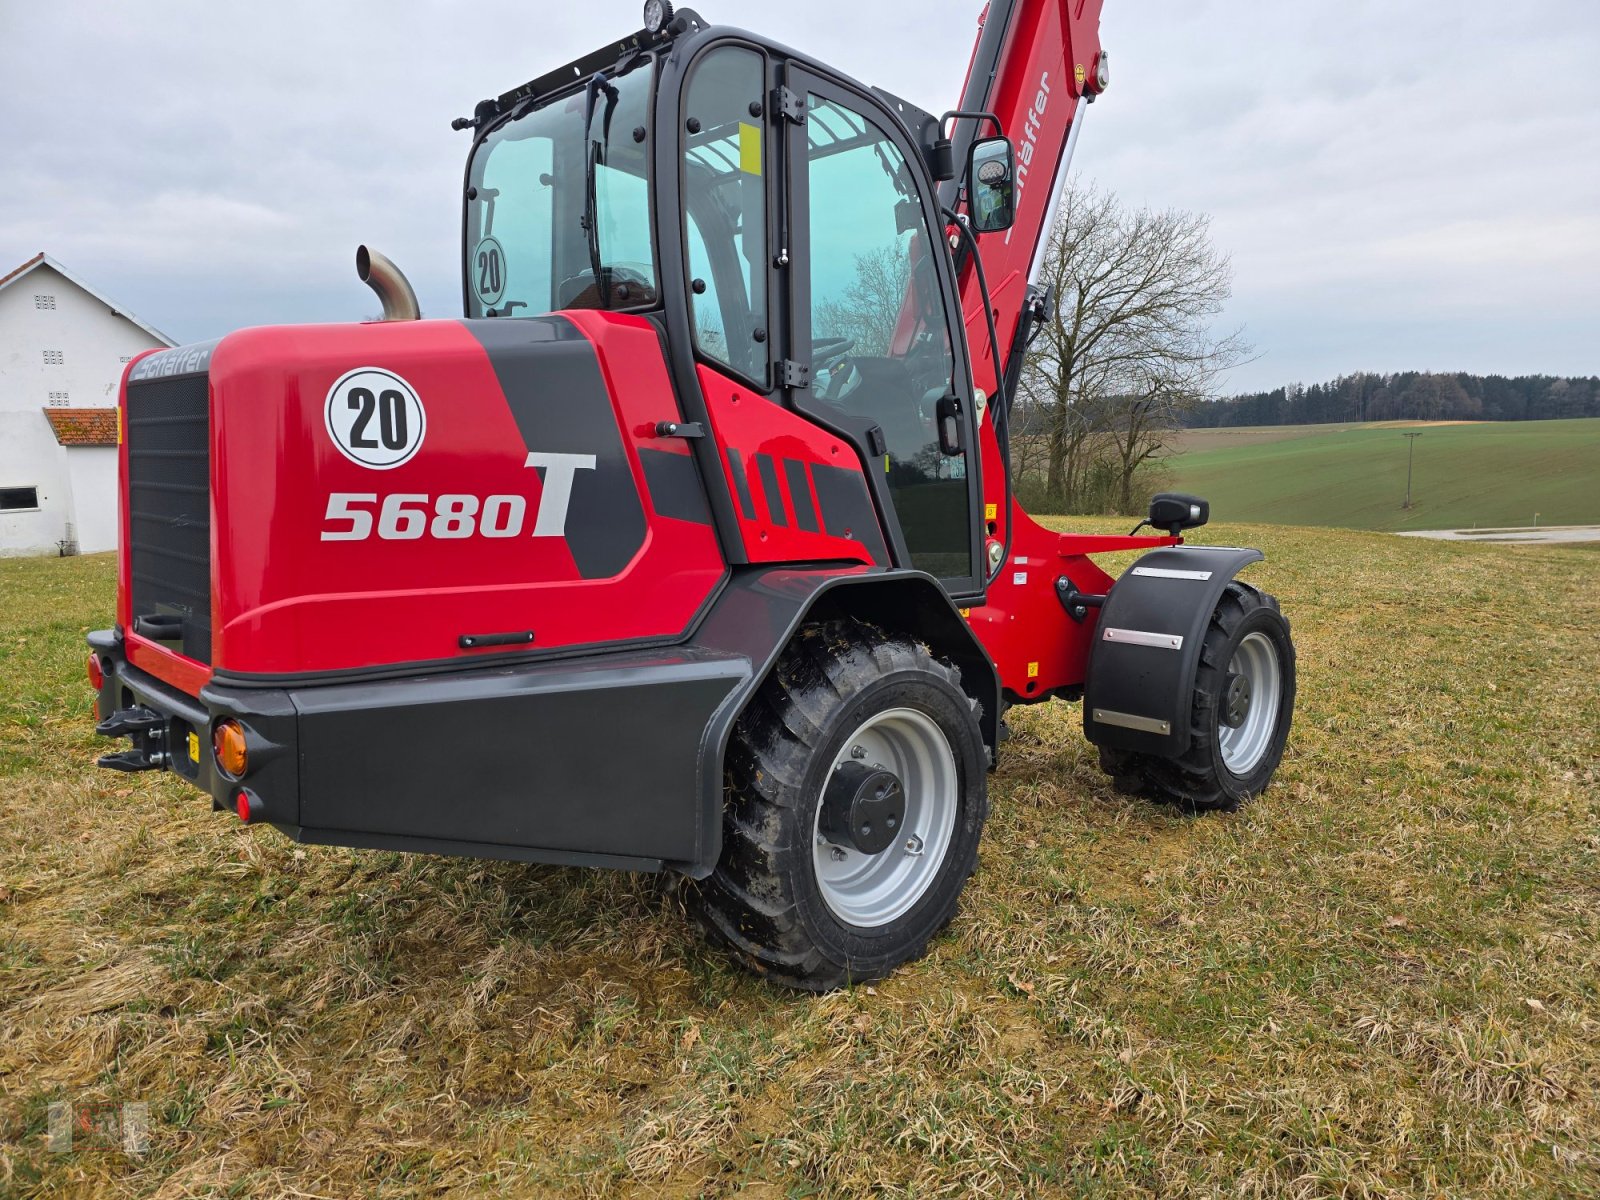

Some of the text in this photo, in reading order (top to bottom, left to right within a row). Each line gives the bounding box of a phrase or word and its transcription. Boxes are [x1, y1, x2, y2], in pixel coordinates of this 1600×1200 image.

[479, 249, 500, 294] 20
[135, 349, 208, 380] Schäffer
[347, 387, 408, 451] 20
